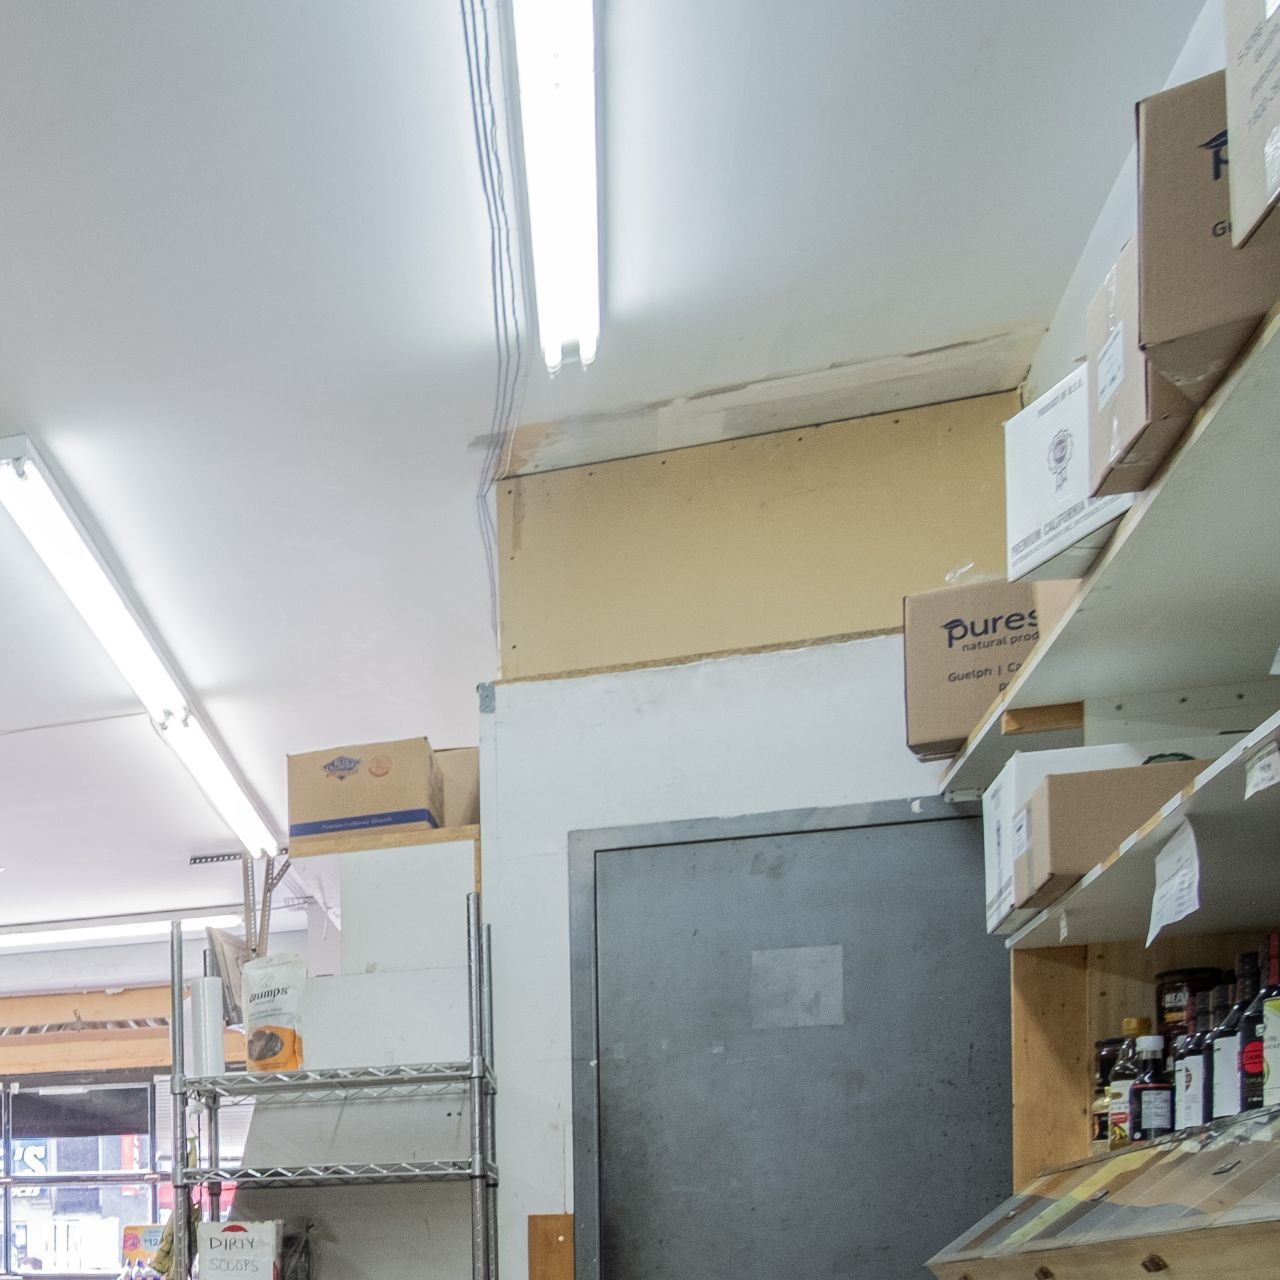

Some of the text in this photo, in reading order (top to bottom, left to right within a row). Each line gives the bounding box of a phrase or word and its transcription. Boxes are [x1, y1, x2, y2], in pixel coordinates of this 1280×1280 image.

[940, 609, 1038, 648] pures
[962, 631, 1040, 652] natural prod
[948, 667, 992, 682] Guelph
[210, 1237, 255, 1250] DIRTY
[210, 1258, 259, 1272] SCOOPS
